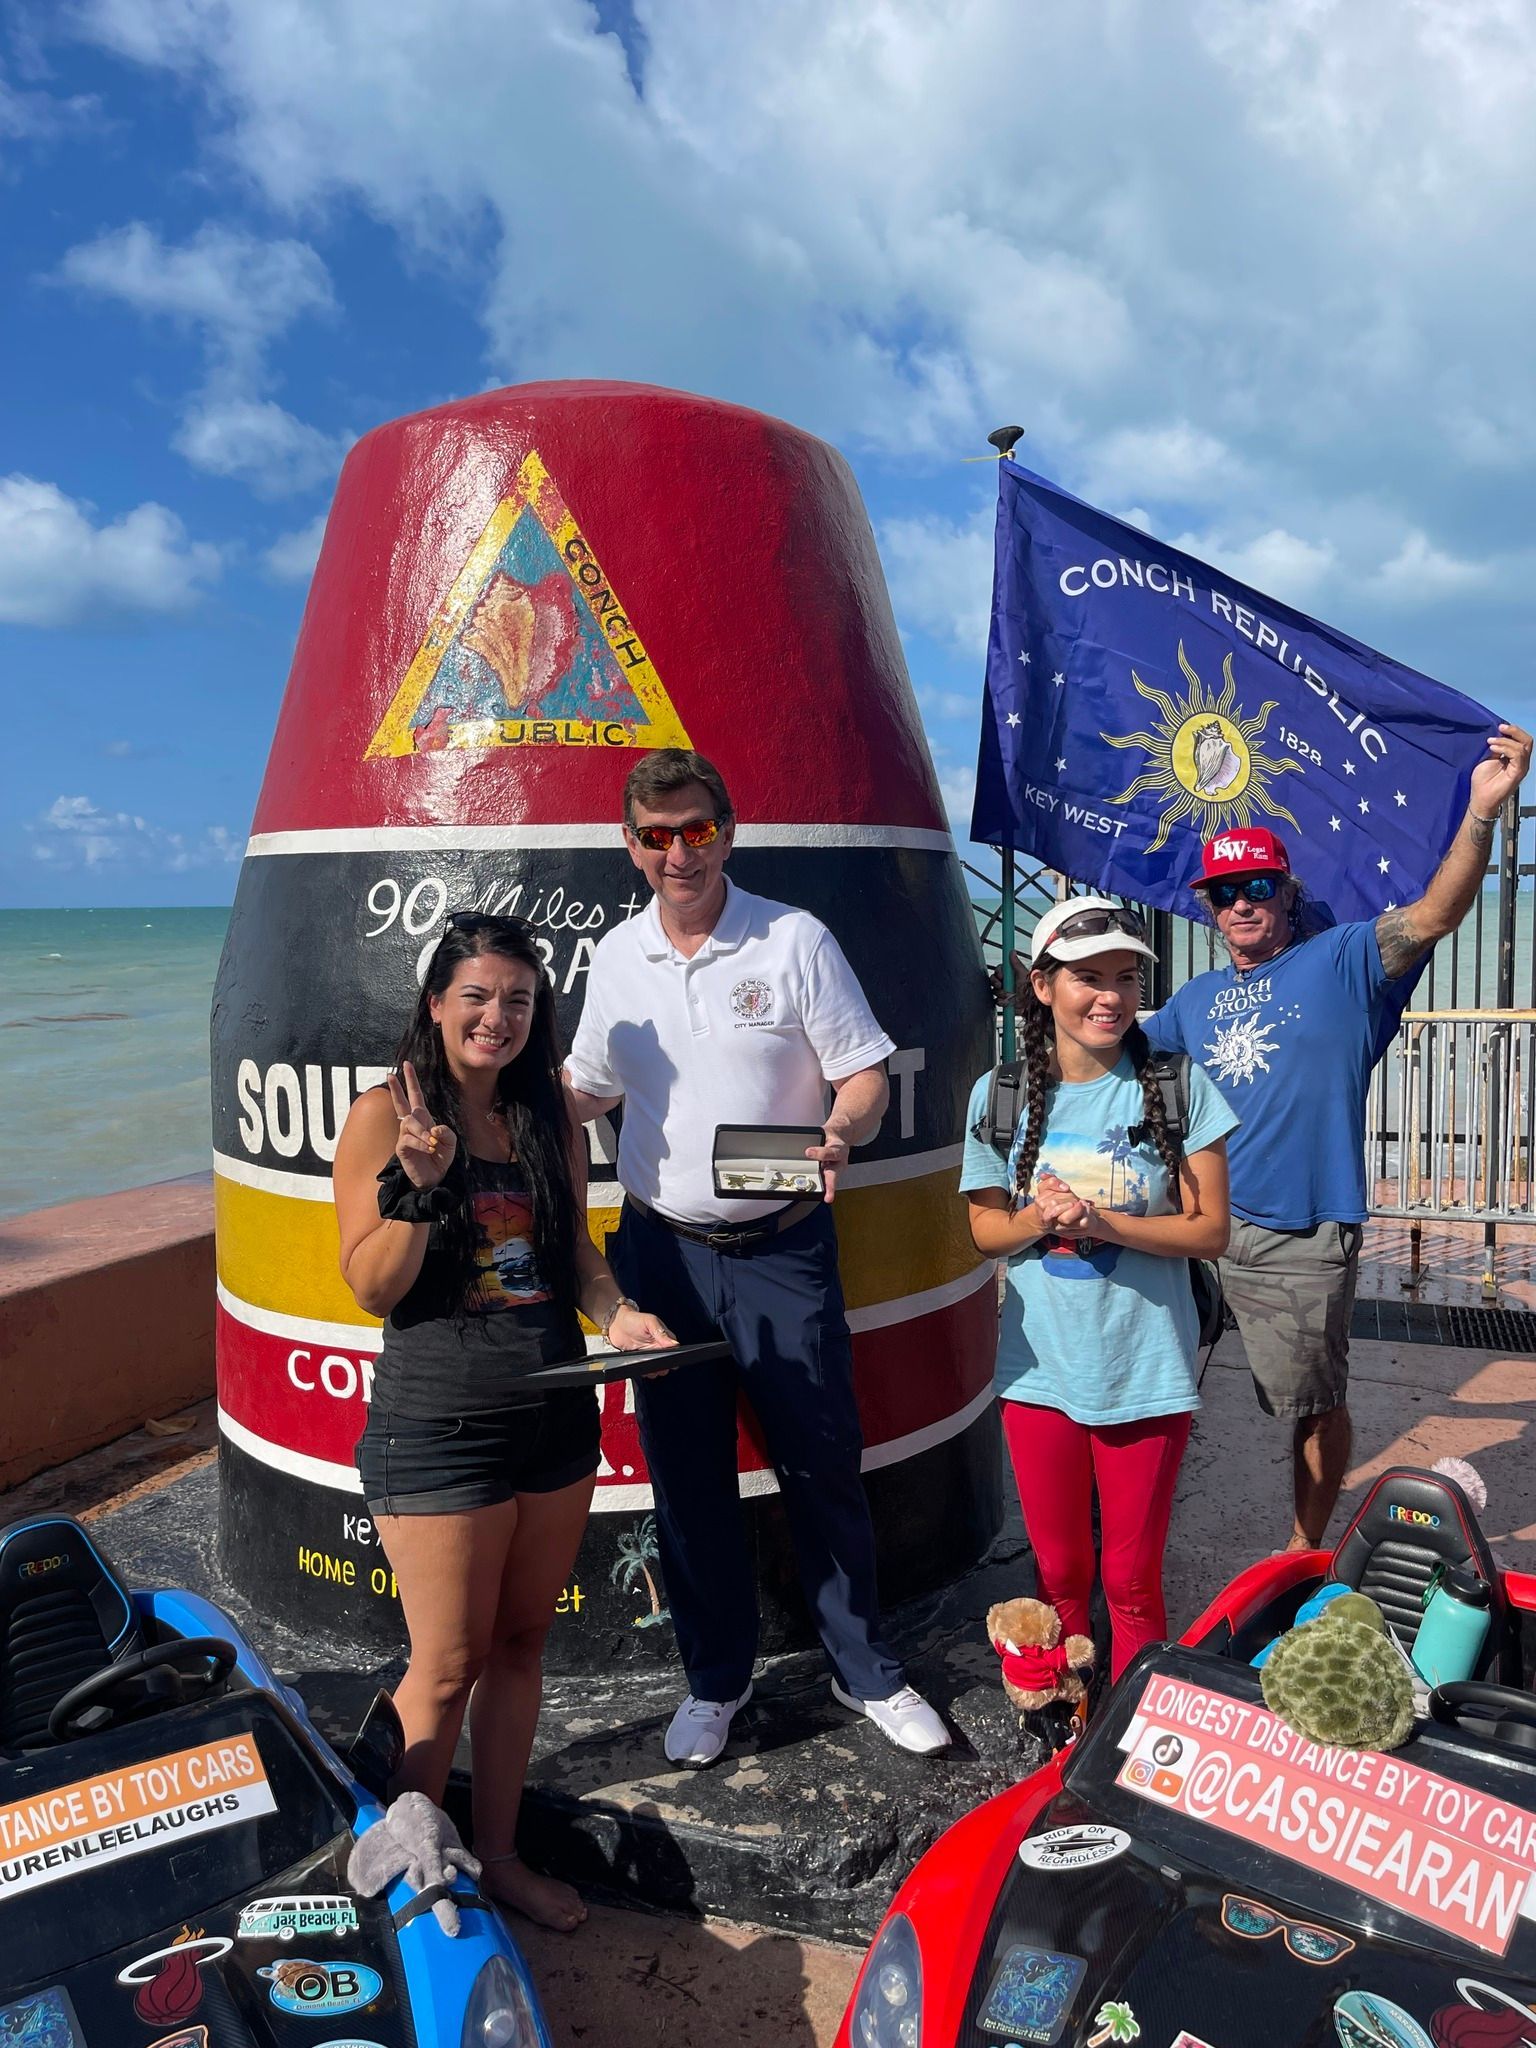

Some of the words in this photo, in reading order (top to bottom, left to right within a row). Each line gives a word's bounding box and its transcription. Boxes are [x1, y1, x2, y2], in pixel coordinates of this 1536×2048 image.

[565, 539, 647, 669] CONCH
[1059, 558, 1196, 603] CONCH
[1210, 588, 1388, 764] REPUBLIC
[1278, 725, 1323, 767] 1828
[1024, 783, 1060, 814] KEY
[1064, 802, 1128, 839] WEST
[1212, 836, 1249, 862] KW
[365, 877, 448, 938] 90
[1207, 993, 1273, 1020] STRONG
[1215, 977, 1272, 1005] CONCH
[748, 1020, 775, 1028] MANAGER
[1389, 1504, 1441, 1529] FREDDO
[19, 1554, 69, 1579] FREDDO
[1142, 1680, 1252, 1741] LONGEST
[1247, 1714, 1377, 1790] DISTANCE
[1375, 1763, 1421, 1806] BY
[1422, 1780, 1483, 1832] TOY
[90, 1782, 126, 1817] BY
[130, 1762, 183, 1806] TOY
[187, 1744, 255, 1788] CARS
[1043, 1827, 1074, 1842] RIDE
[1087, 1826, 1107, 1835] ON
[1185, 1750, 1525, 1940] @CASSIEARAN
[1038, 1845, 1115, 1864] REGARDLESS
[294, 1970, 360, 2002] OB
